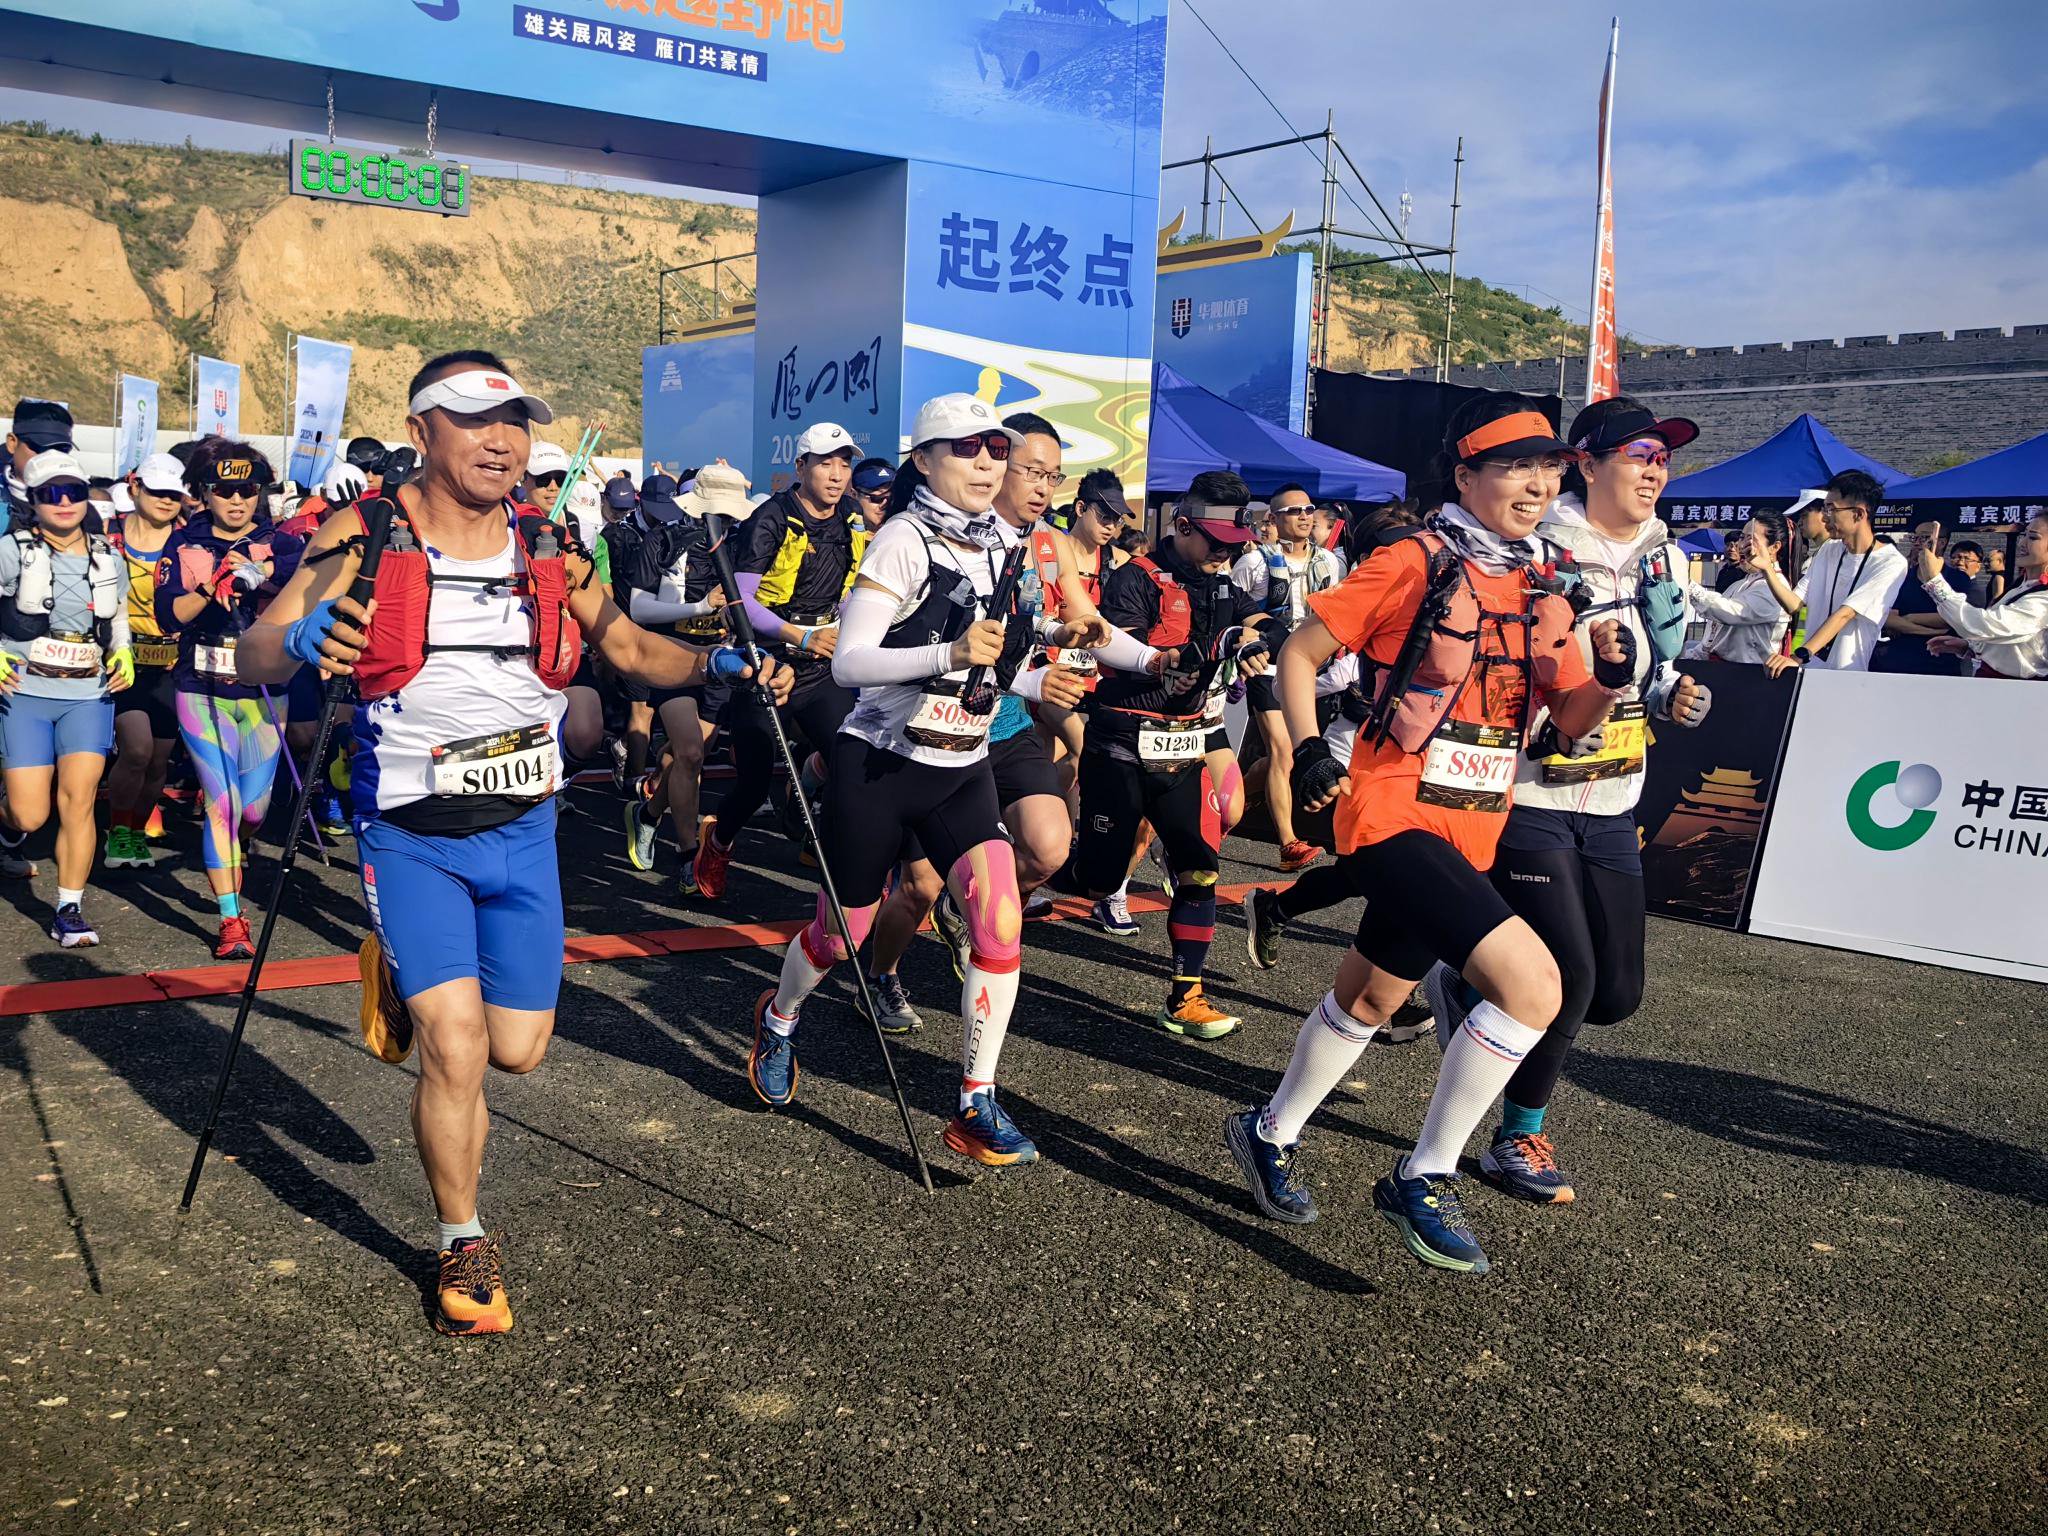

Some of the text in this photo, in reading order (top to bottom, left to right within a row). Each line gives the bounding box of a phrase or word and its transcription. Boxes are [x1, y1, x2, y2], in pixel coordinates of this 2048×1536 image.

[524, 11, 760, 76] 雄关展风姿 雁门共豪情
[937, 211, 1134, 309] 起终点
[221, 460, 250, 478] Buff
[1671, 505, 1752, 521] 嘉宾观赛区
[1153, 735, 1198, 753] S1230
[462, 754, 544, 795] S0104
[1447, 750, 1513, 781] S8877
[1954, 824, 2048, 858] CHIN
